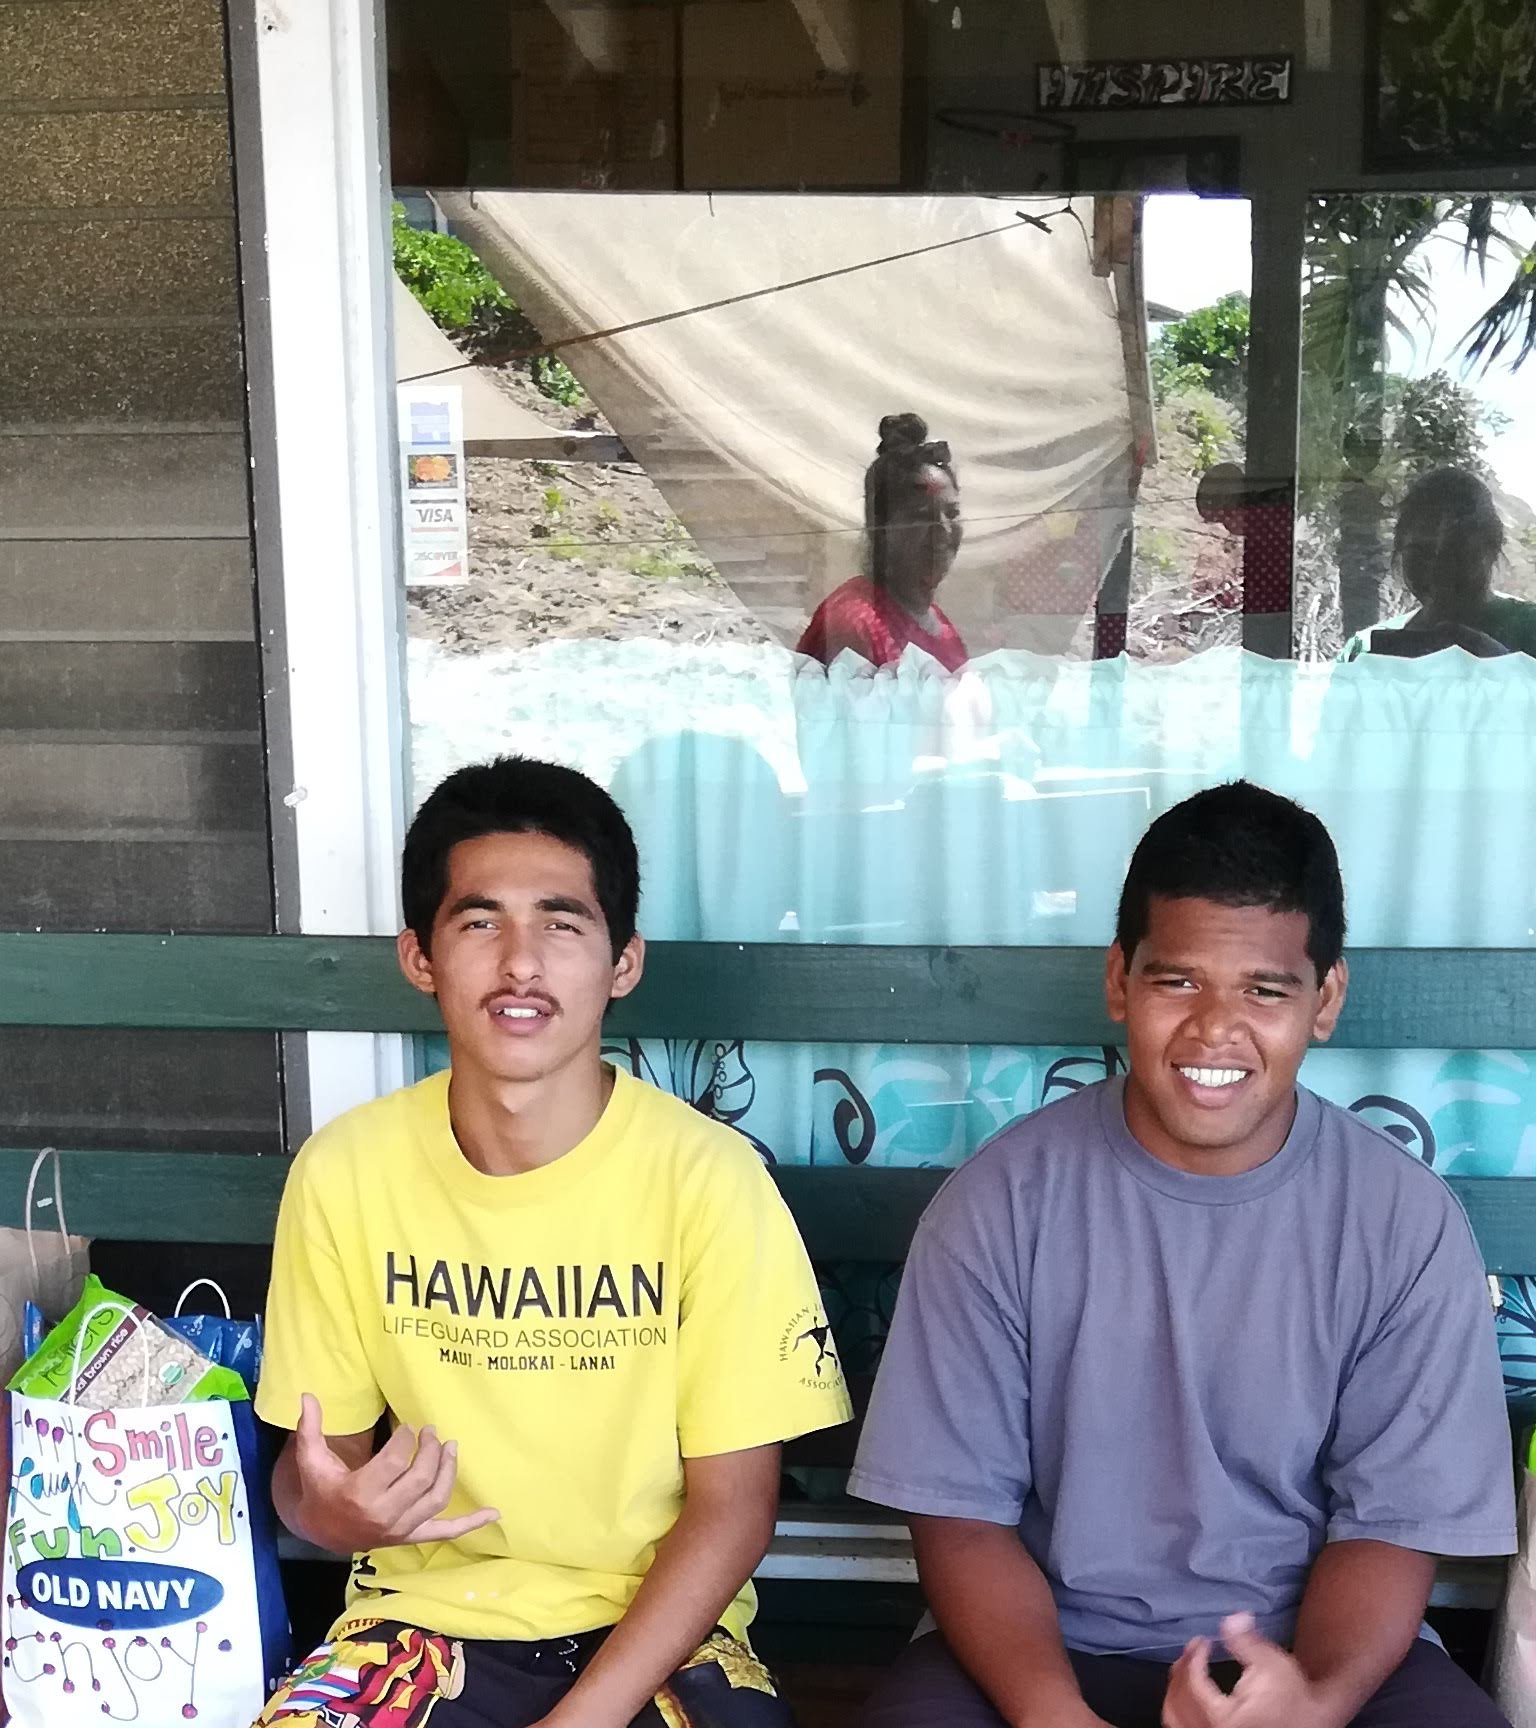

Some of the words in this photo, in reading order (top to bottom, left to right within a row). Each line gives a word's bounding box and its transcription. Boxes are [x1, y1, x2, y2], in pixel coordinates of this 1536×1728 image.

[416, 508, 454, 523] VISA
[414, 551, 459, 562] DISCOVER
[386, 1251, 664, 1320] HAWAIIAN
[86, 1347, 115, 1382] brown
[111, 1327, 130, 1348] rice
[383, 1315, 509, 1349] LIFEGUARD
[515, 1326, 667, 1349] ASSOCIATION
[779, 1306, 810, 1362] HAWAIIAN
[439, 1348, 473, 1368] MAUI
[487, 1355, 556, 1371] MOLOKAI
[570, 1355, 616, 1371] LANAI
[84, 1409, 225, 1478] Smile
[10, 1456, 118, 1534] Laugh
[31, 1571, 91, 1609] OLD
[96, 1577, 196, 1612] NAVY
